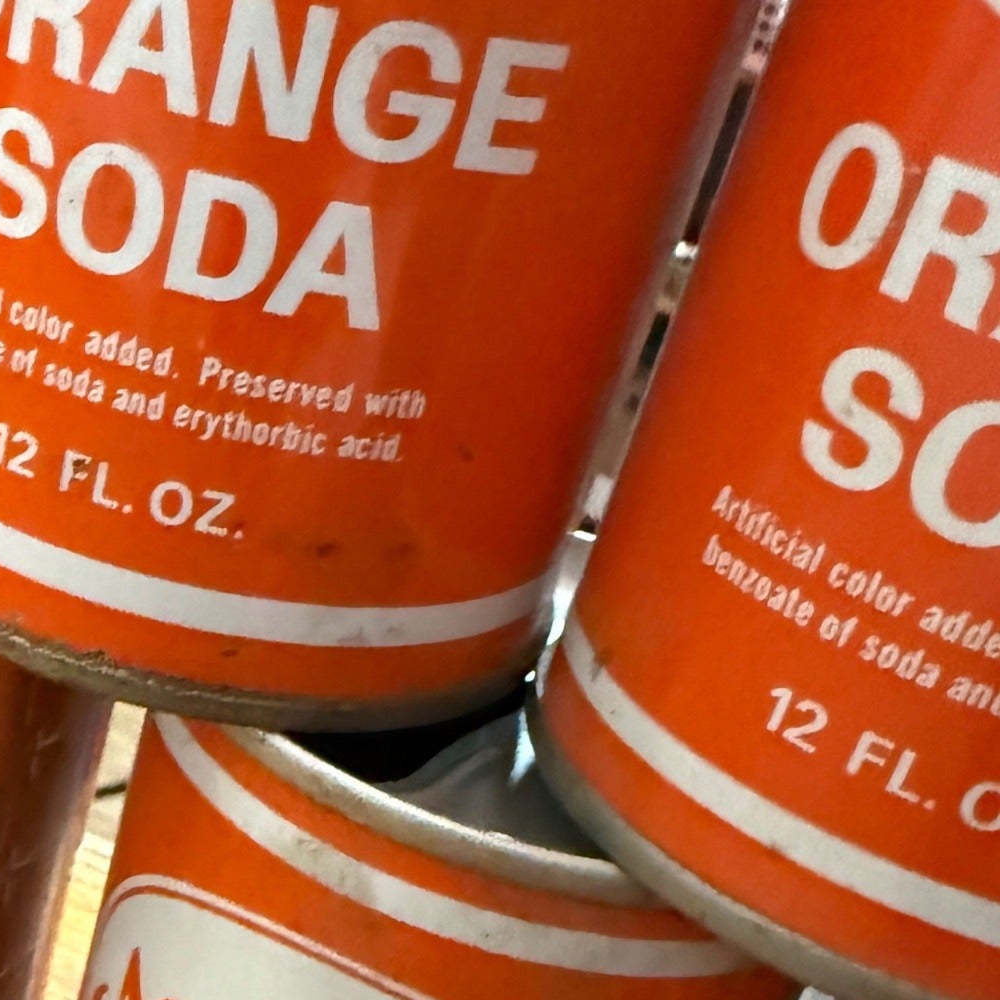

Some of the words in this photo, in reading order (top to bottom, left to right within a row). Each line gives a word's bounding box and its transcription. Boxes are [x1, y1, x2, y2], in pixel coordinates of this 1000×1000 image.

[799, 121, 1000, 341] OR
[8, 300, 74, 344] color
[84, 330, 179, 379] added.
[198, 356, 354, 413] Preserved
[364, 388, 426, 419] with
[10, 348, 38, 378] of
[42, 363, 105, 403] soda
[111, 391, 166, 421] and
[172, 403, 328, 456] erythorbic
[58, 448, 132, 514] FL.
[149, 481, 243, 540] OZ.
[711, 485, 826, 574] Artificial
[827, 562, 916, 617] color
[702, 533, 816, 627] benzoate
[818, 614, 859, 648] of
[859, 634, 942, 689] soda
[766, 687, 829, 754] 12
[846, 730, 936, 811] FL.
